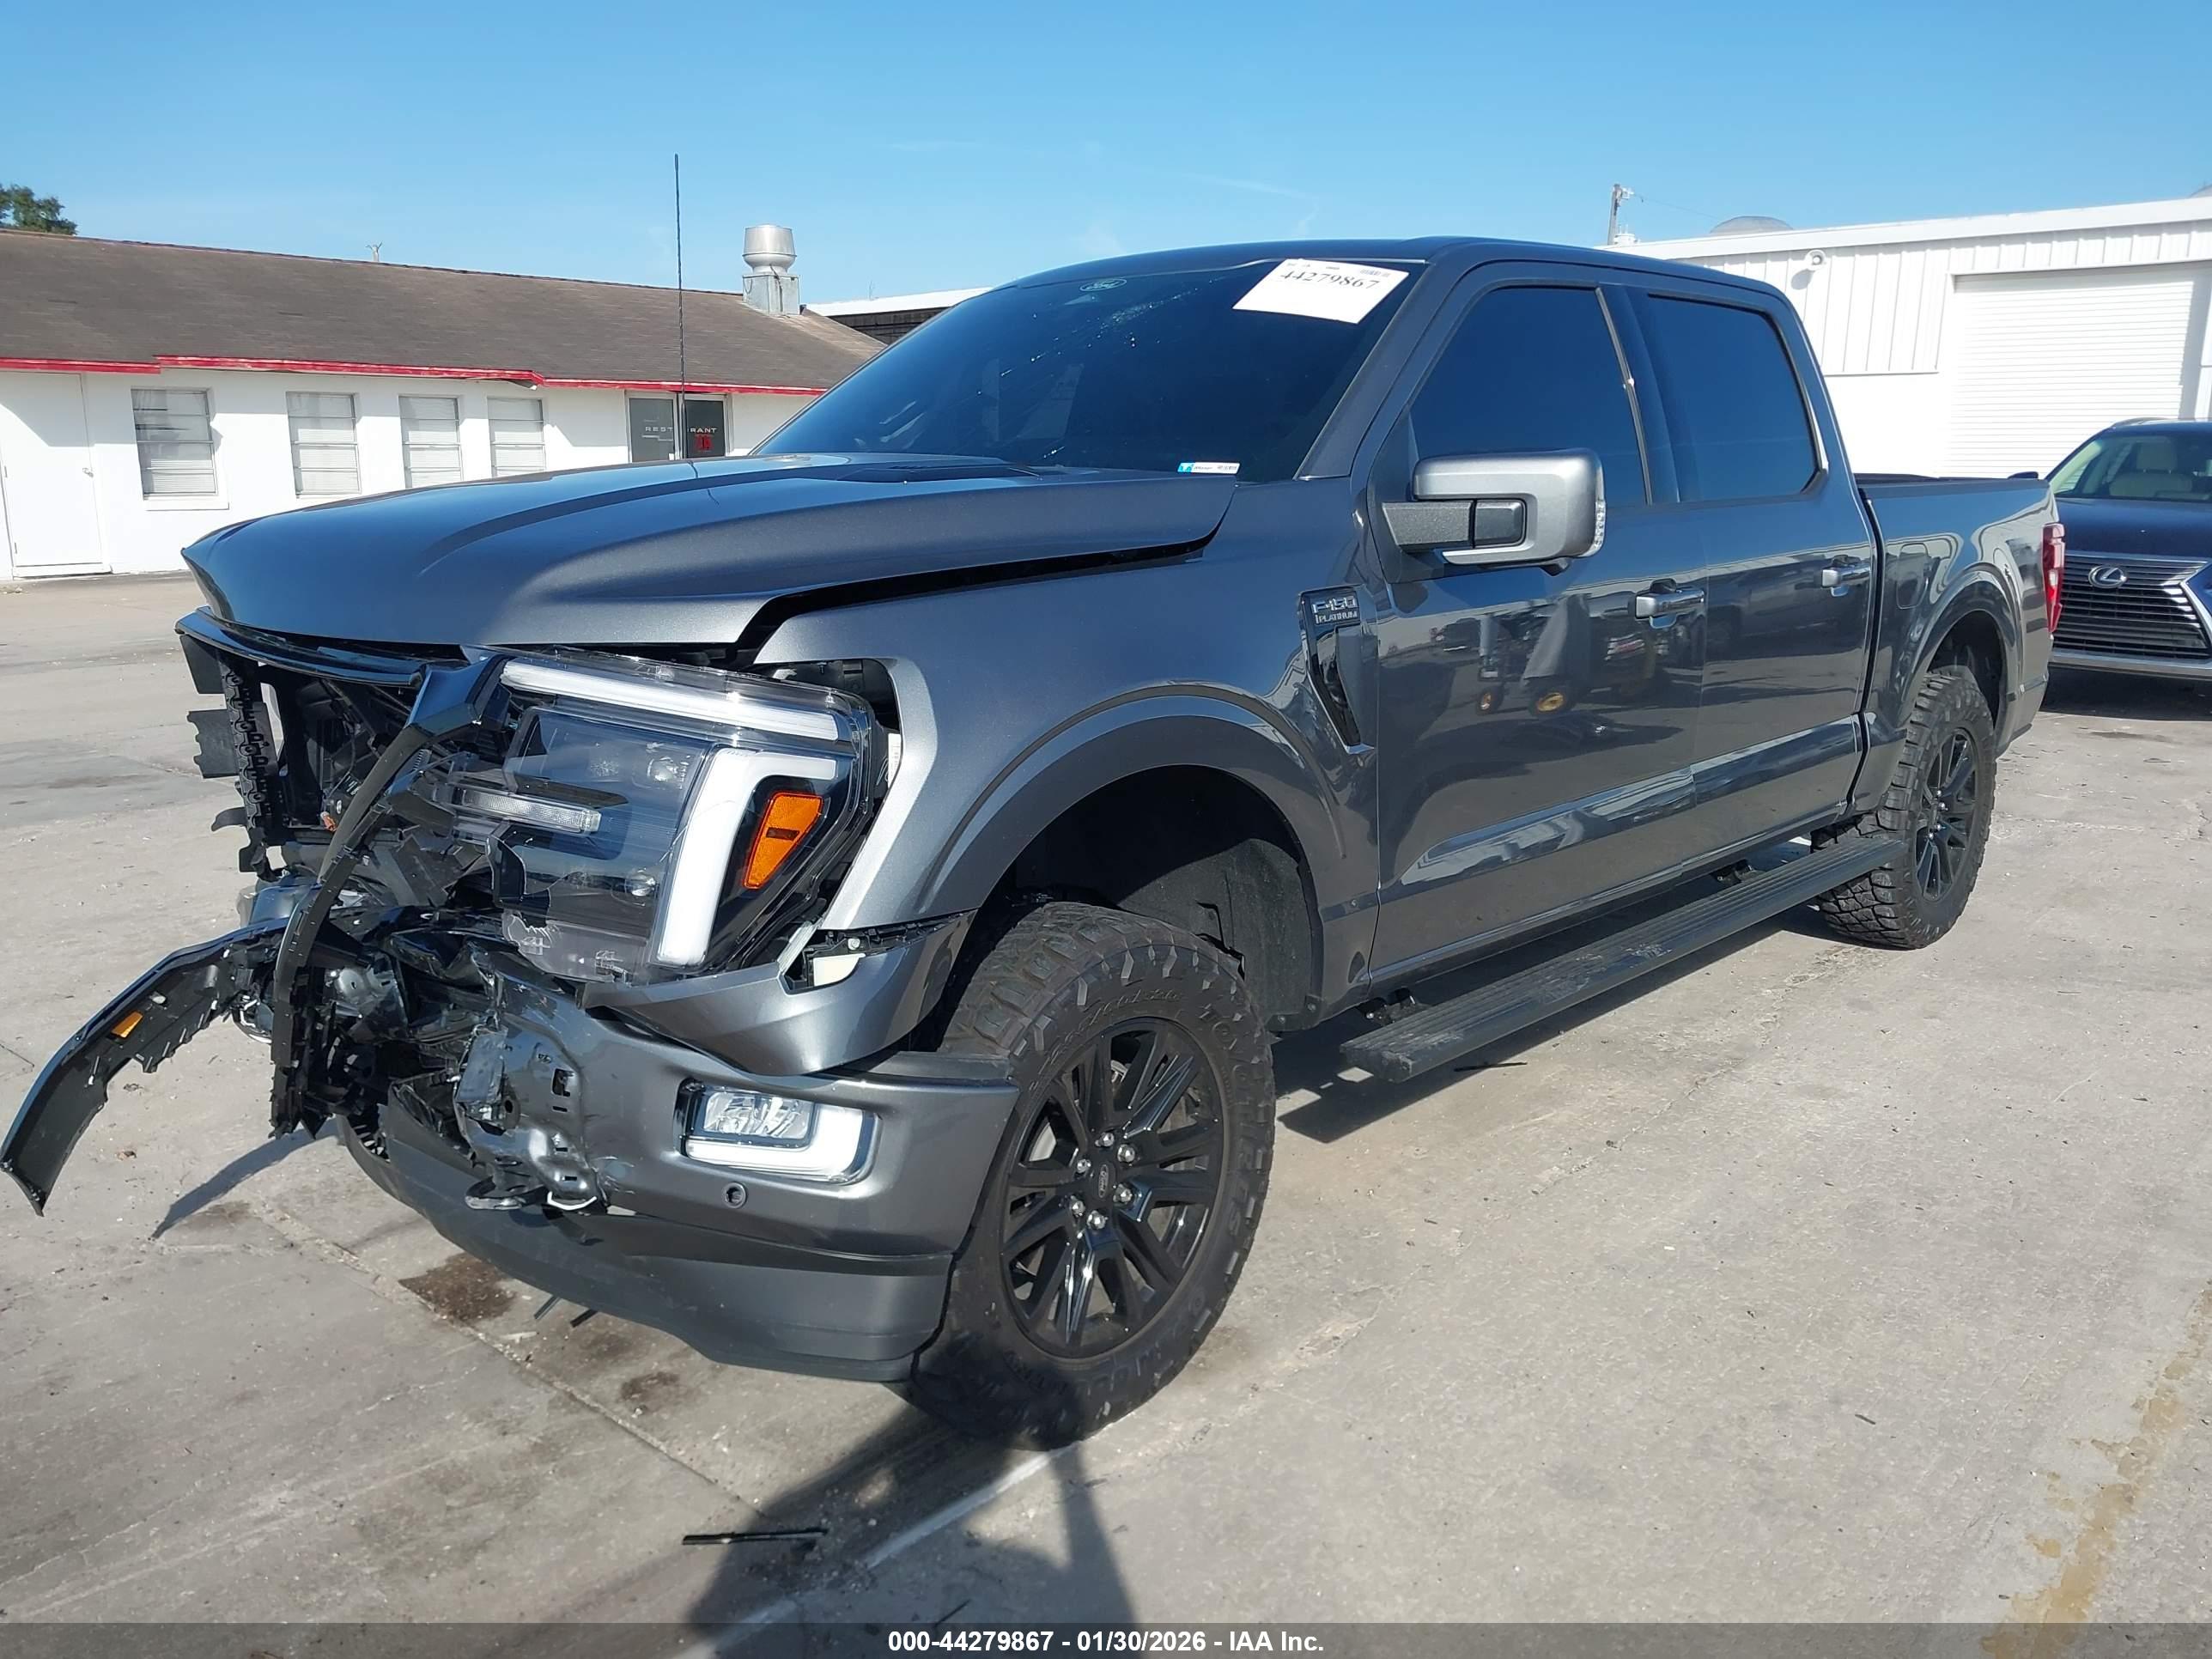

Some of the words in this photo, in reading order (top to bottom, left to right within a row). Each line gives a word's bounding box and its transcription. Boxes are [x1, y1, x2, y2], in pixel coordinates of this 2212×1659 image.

[1279, 270, 1381, 289] 44279867
[1312, 597, 1358, 613] F-150
[1318, 611, 1358, 623] PLATINUM
